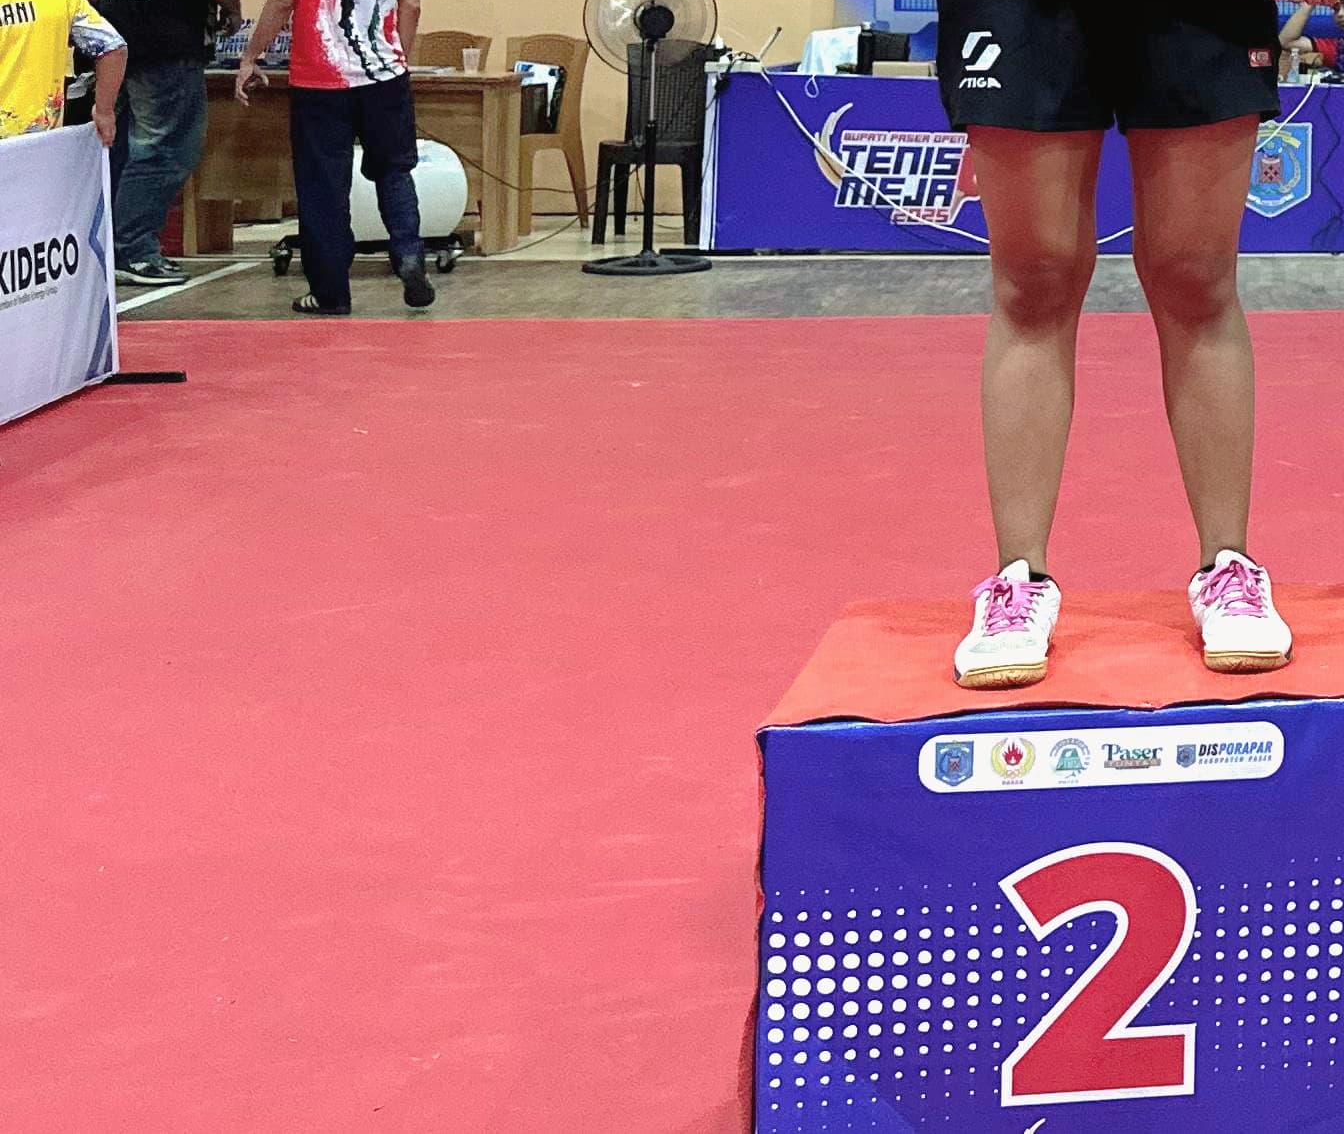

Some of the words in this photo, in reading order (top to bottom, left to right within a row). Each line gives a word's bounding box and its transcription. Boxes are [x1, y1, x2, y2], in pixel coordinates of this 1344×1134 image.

[959, 77, 1001, 88] STIGA
[844, 132, 887, 141] BUPATI
[890, 133, 930, 143] PASER
[934, 134, 966, 144] OPEN
[842, 144, 964, 175] TENIS
[837, 175, 957, 207] MEJA
[891, 208, 949, 224] 2025
[1101, 743, 1163, 761] Paser
[1198, 740, 1273, 757] DISPORAPAR
[1006, 848, 1191, 1100] 2
